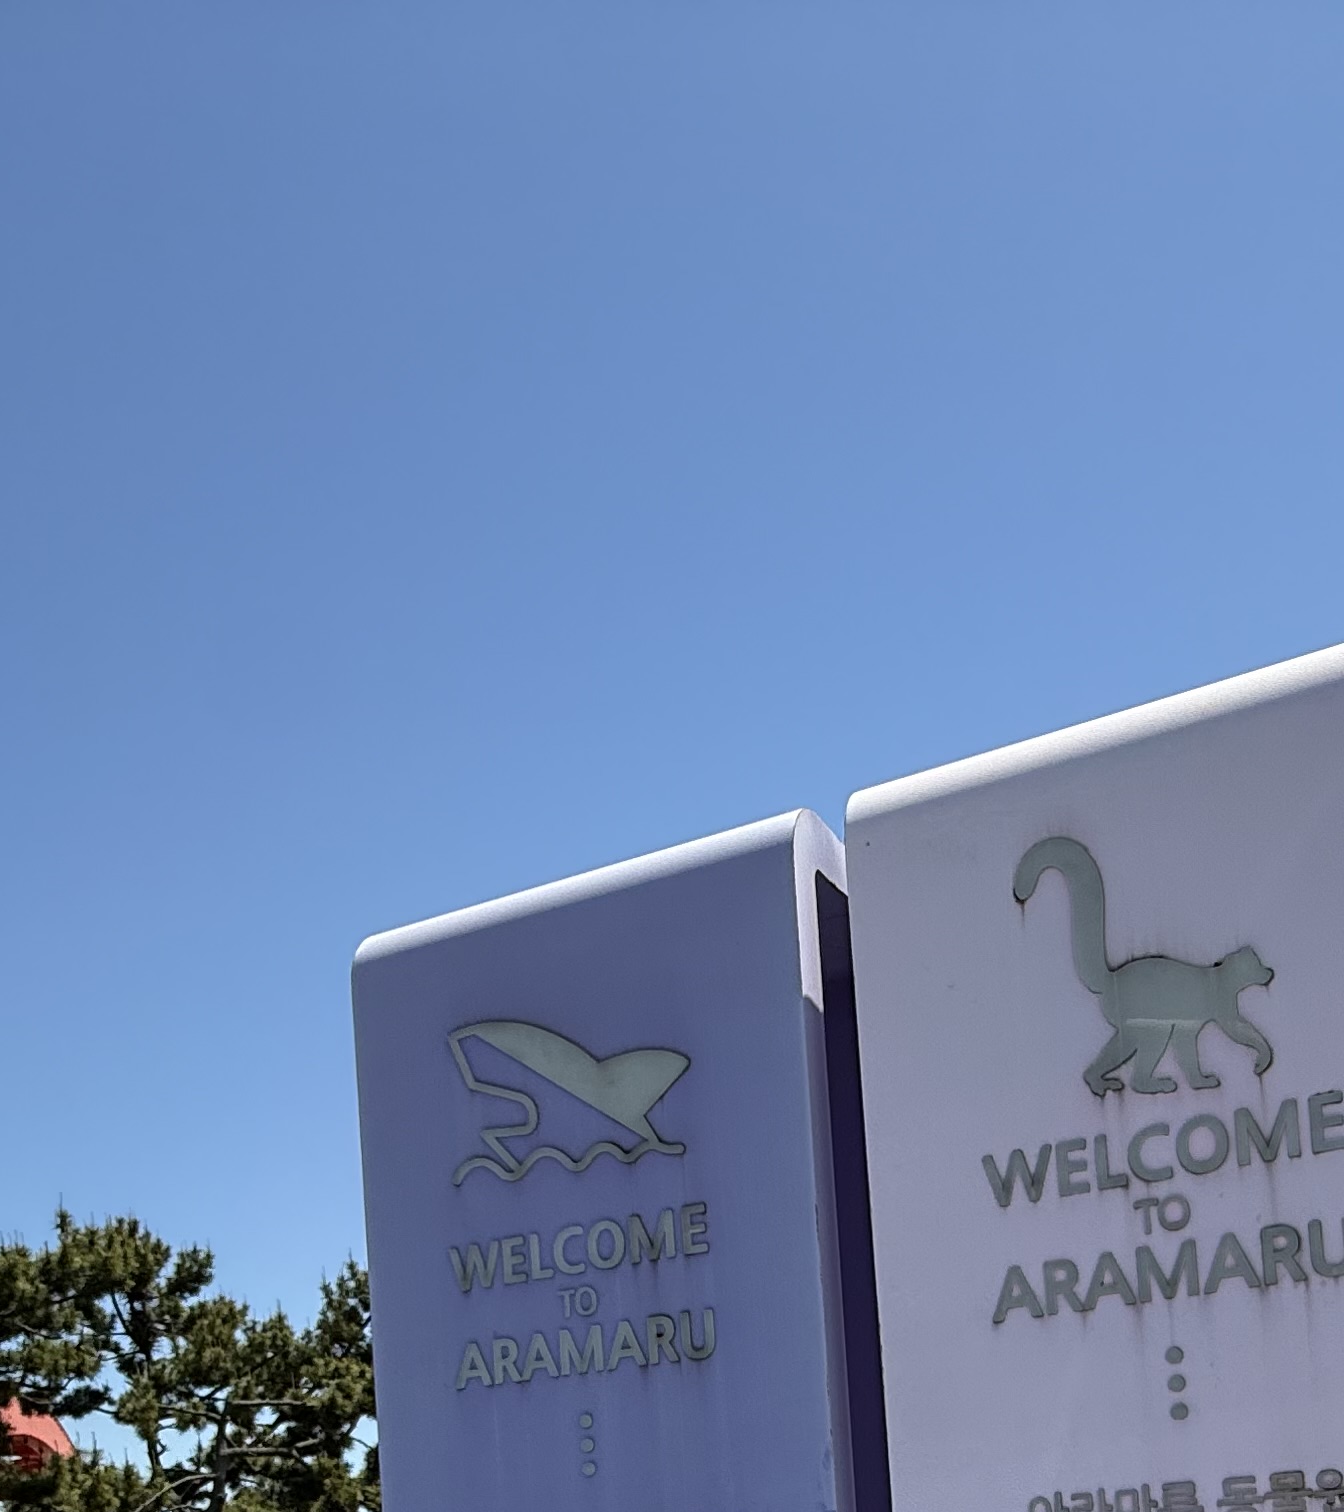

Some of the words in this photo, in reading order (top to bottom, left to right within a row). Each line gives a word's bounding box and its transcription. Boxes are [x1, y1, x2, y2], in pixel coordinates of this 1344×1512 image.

[1133, 1195, 1191, 1234] TO
[450, 1202, 709, 1292] WELCOME
[560, 1286, 597, 1318] TO
[457, 1308, 716, 1390] ARAMARU
